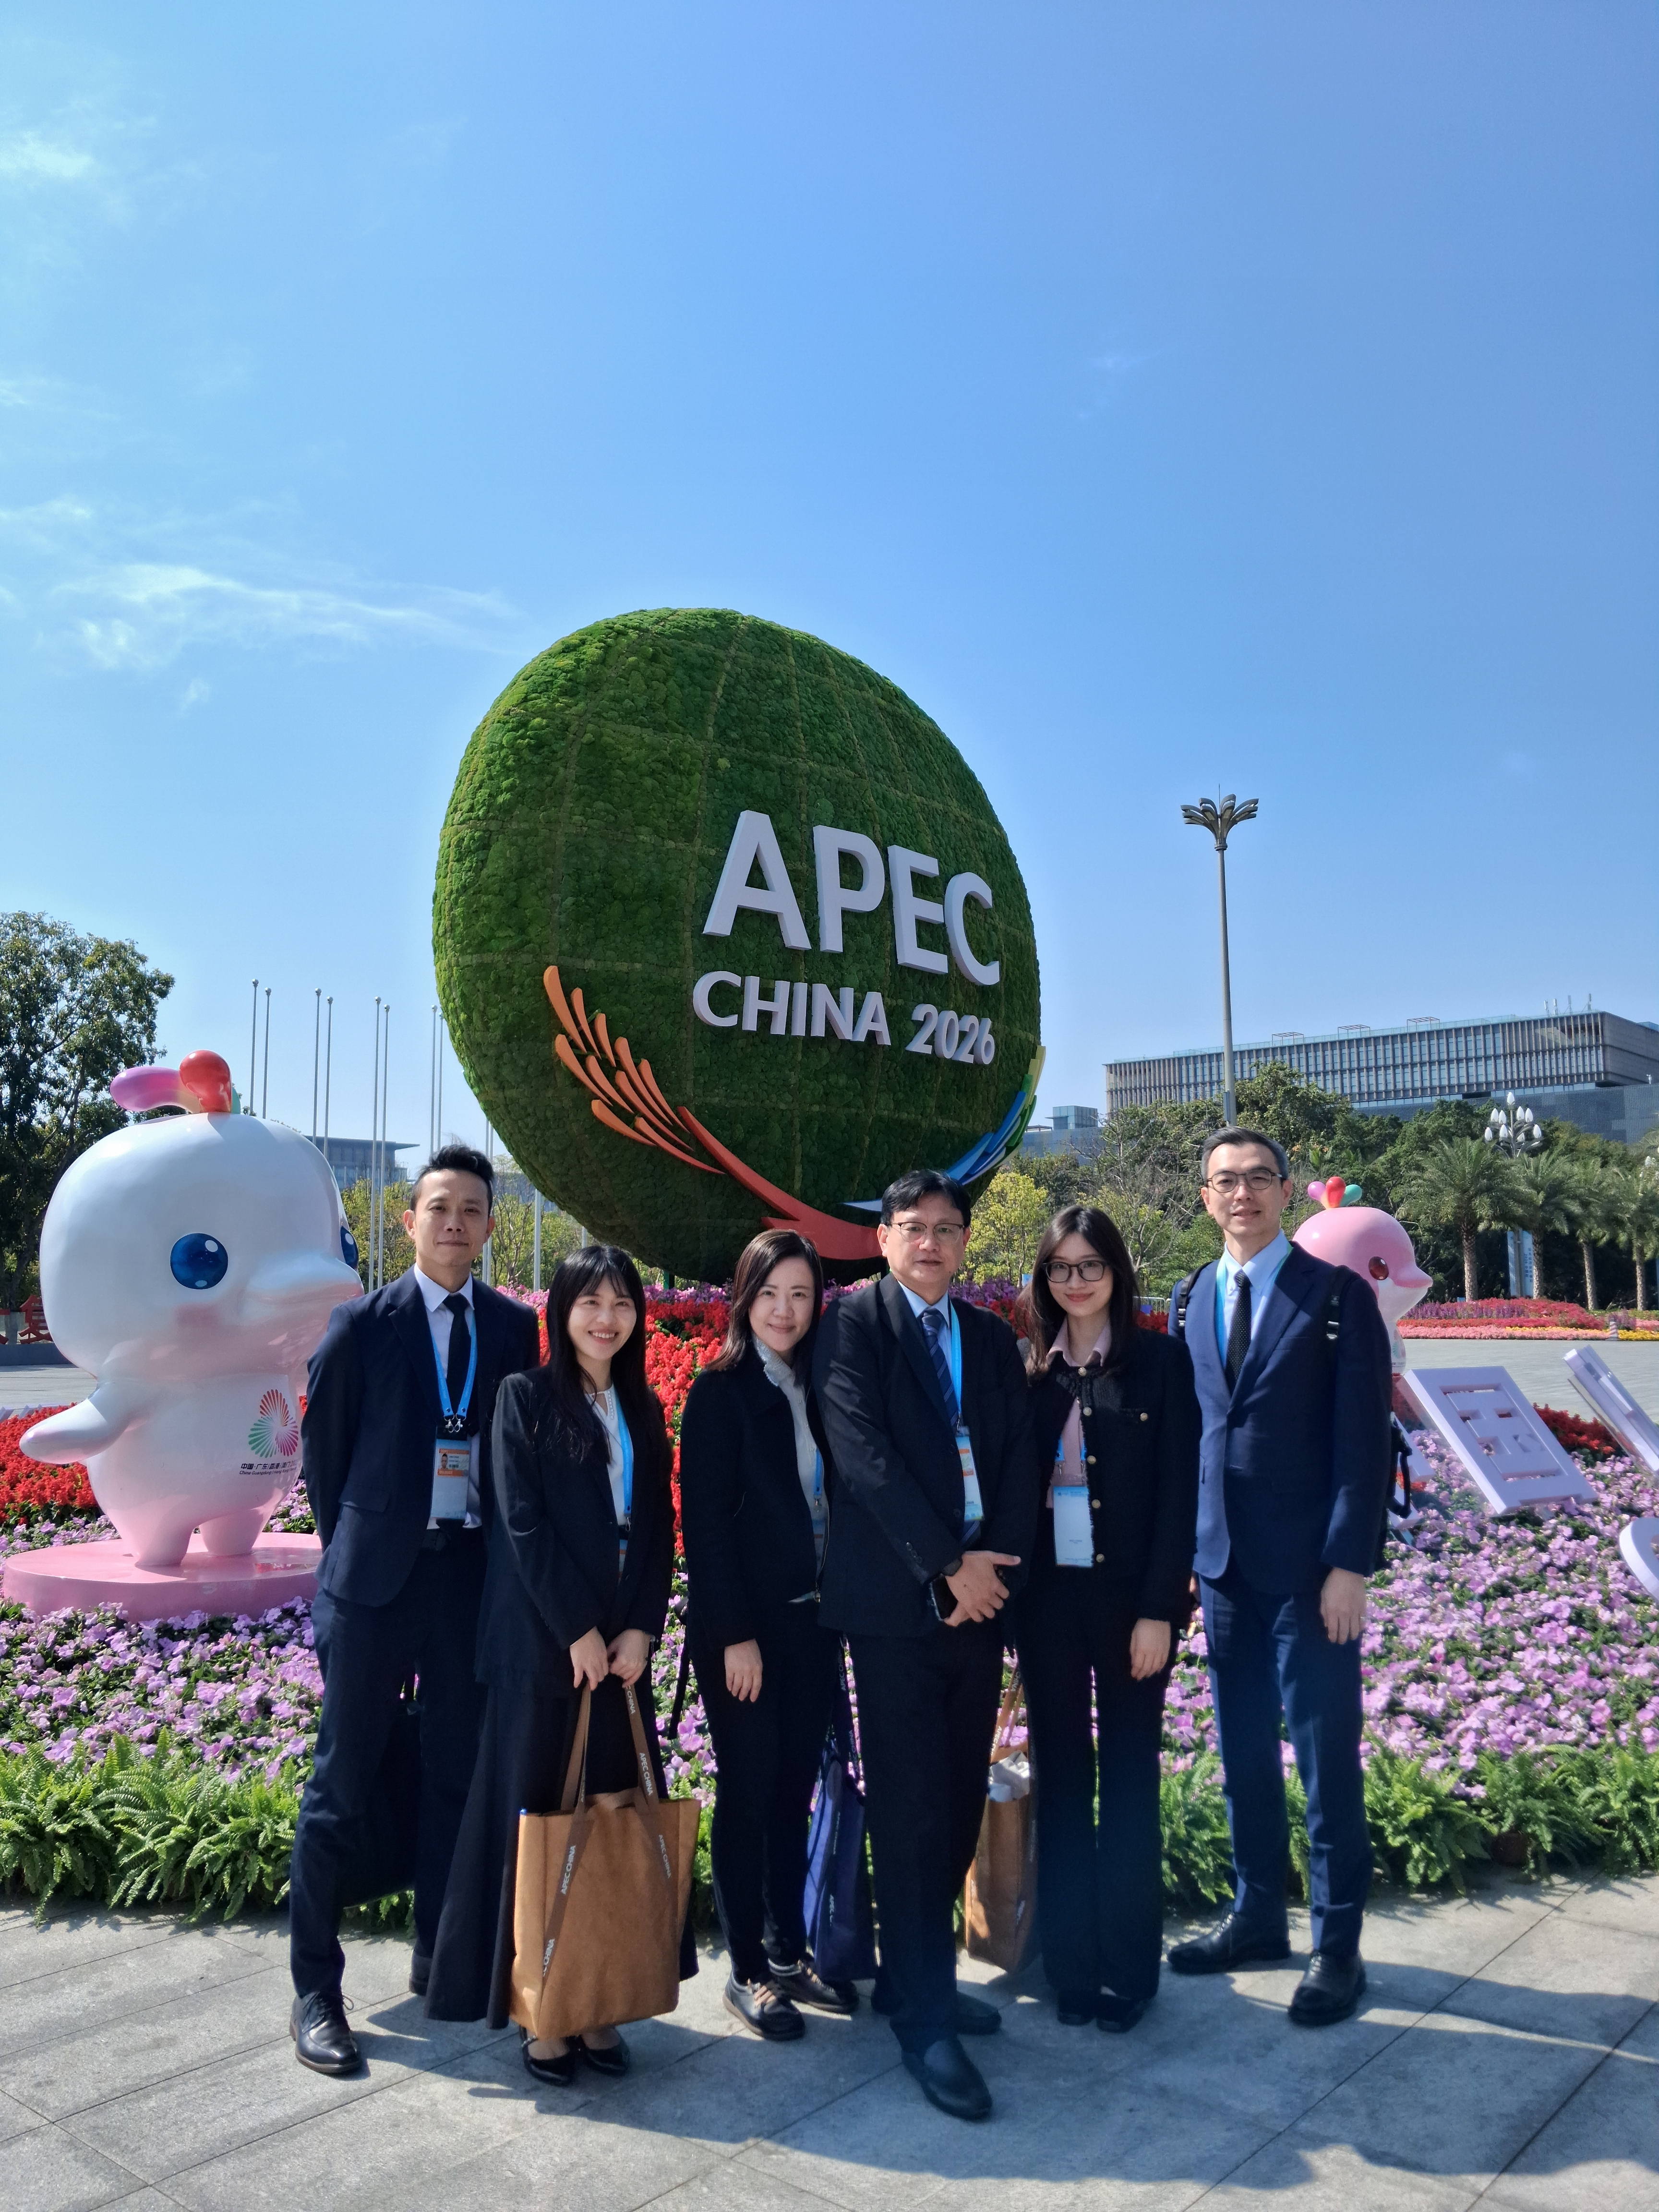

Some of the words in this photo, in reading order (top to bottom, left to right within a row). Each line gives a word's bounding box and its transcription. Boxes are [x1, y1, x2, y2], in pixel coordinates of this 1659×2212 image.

[702, 810, 1000, 986] APEC
[693, 971, 891, 1046] CHINA
[905, 1003, 995, 1065] 2026
[626, 1691, 636, 1714] CHINA
[1010, 1671, 1021, 1692] CHINA
[994, 1726, 1002, 1744] APEC
[639, 1753, 649, 1771] APEC
[644, 1771, 653, 1795] CHINA
[560, 1872, 570, 1895] APEC
[566, 1845, 576, 1872] CHINA
[658, 1835, 666, 1854] APEC
[663, 1854, 672, 1878] CHINA
[543, 1938, 555, 1966] CHINA
